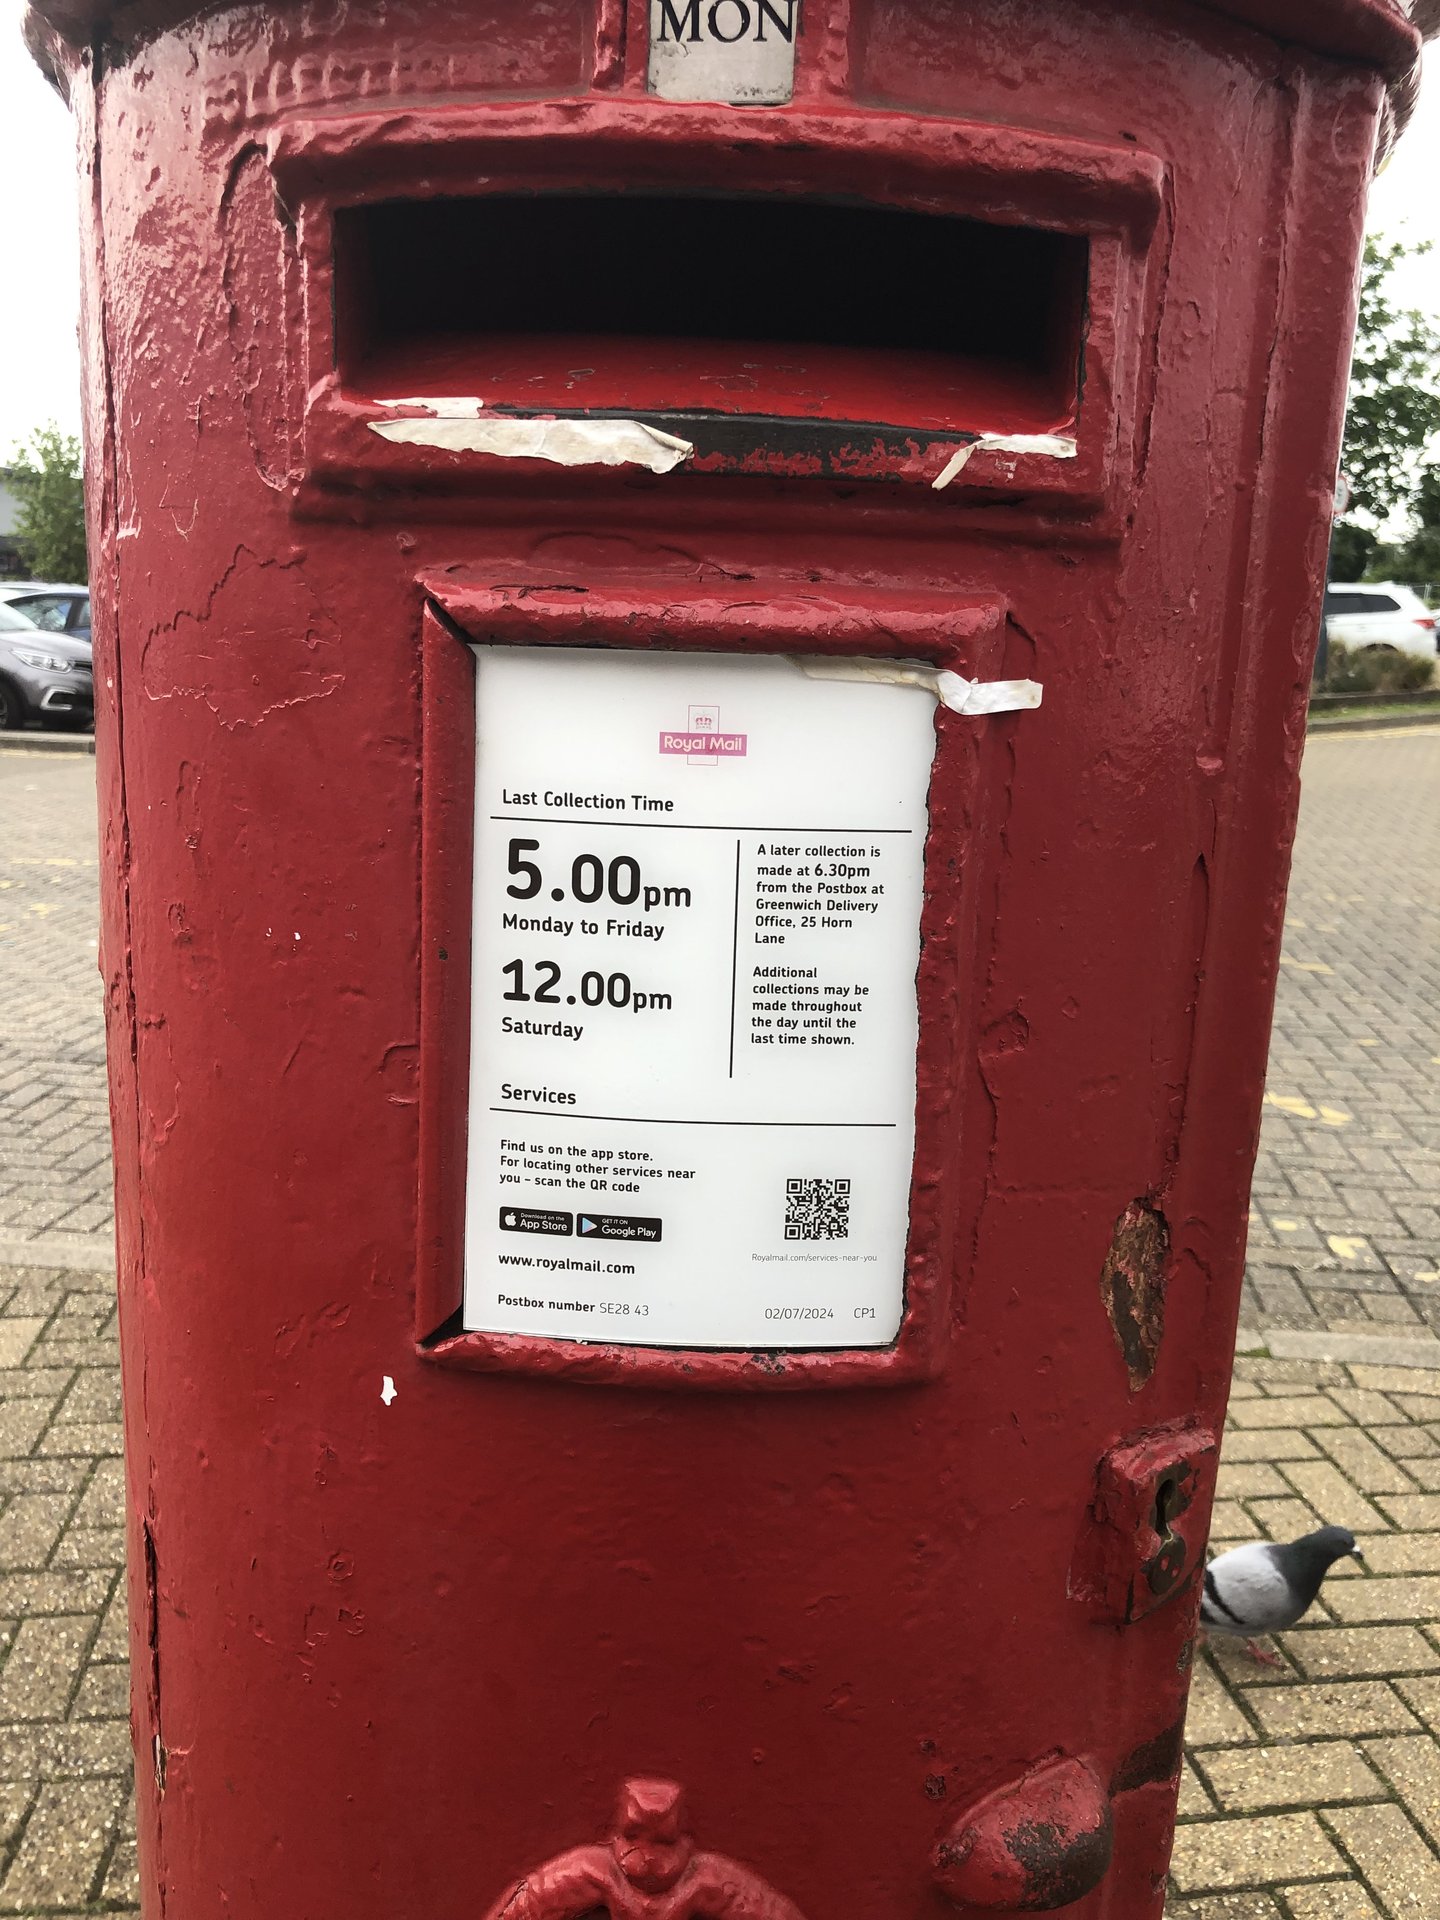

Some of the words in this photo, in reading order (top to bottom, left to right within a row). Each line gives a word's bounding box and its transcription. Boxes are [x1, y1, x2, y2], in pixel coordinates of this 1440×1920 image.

[656, 0, 797, 43] MON
[664, 735, 706, 752] Royal
[709, 737, 742, 751] Mail
[503, 789, 537, 805] Last
[544, 791, 625, 809] Collection
[631, 795, 673, 811] Time
[758, 844, 766, 855] A
[771, 845, 800, 855] later
[805, 846, 865, 856] collection
[871, 846, 880, 857] is
[507, 838, 691, 912] 5.00pm
[758, 865, 792, 875] made
[797, 866, 809, 876] at
[815, 864, 869, 879] 6.30pm
[757, 881, 786, 892] from
[792, 882, 812, 893] the
[818, 883, 866, 894] Postbox
[872, 885, 884, 894] at
[756, 899, 821, 910] Greenwich
[827, 900, 878, 913] Delivery
[503, 913, 573, 936] Monday
[580, 920, 598, 934] to
[607, 920, 664, 941] Friday
[756, 916, 795, 928] Office,
[801, 916, 816, 927] 25
[822, 917, 852, 927] Horn
[755, 933, 785, 943] Lane
[753, 966, 817, 978] Additional
[503, 959, 671, 1013] 12.00pm
[753, 983, 819, 994] collections
[824, 987, 850, 997] may
[855, 985, 869, 995] be
[753, 1000, 786, 1010] made
[792, 1001, 862, 1013] throughout
[502, 1017, 583, 1041] Saturday
[752, 1017, 771, 1027] the
[777, 1017, 798, 1030] day
[804, 1017, 831, 1028] until
[836, 1018, 856, 1028] the
[752, 1033, 774, 1043] last
[779, 1033, 806, 1044] time
[812, 1034, 854, 1044] shown.
[502, 1084, 576, 1104] Services
[501, 1140, 525, 1151] Find
[531, 1145, 543, 1153] us
[567, 1146, 586, 1156] the
[591, 1150, 613, 1160] app
[618, 1151, 652, 1161] store.
[501, 1156, 519, 1167] For
[524, 1158, 570, 1174] locating
[576, 1163, 608, 1174] other
[613, 1166, 662, 1177] services
[500, 1174, 520, 1184] you
[535, 1178, 561, 1186] scan
[566, 1178, 585, 1189] the
[591, 1180, 607, 1190] QR
[612, 1182, 639, 1192] code
[520, 1219, 539, 1229] App
[542, 1221, 568, 1231] Store
[602, 1225, 635, 1237] Google
[638, 1228, 656, 1238] Play
[499, 1255, 634, 1274] www.royalmail.com
[752, 1253, 877, 1262] Royalmail.com/services-near-you
[498, 1294, 543, 1308] Postbox
[549, 1301, 595, 1312] number
[600, 1303, 629, 1315] SE28
[635, 1305, 648, 1316] 43
[765, 1308, 833, 1319] 02/07/2024
[854, 1308, 875, 1318] CP1
